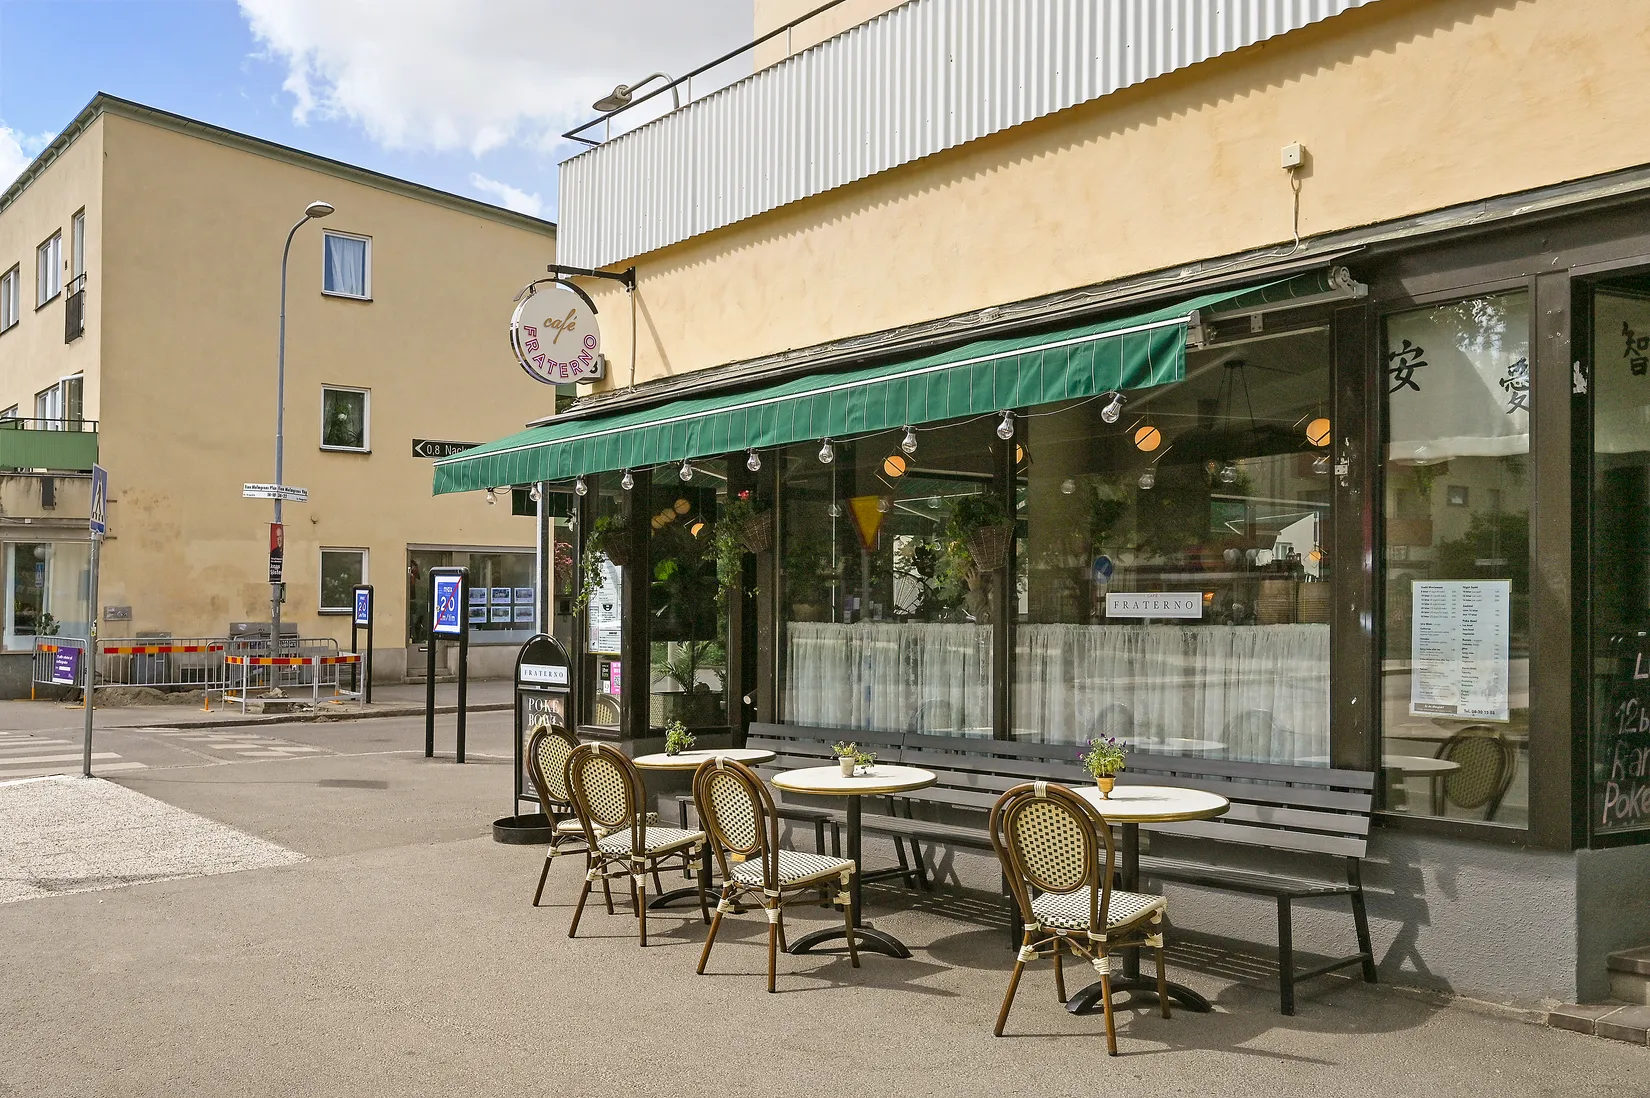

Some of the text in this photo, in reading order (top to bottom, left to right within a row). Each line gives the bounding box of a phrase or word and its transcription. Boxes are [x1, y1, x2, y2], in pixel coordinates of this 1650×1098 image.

[543, 308, 577, 345] café
[523, 325, 597, 379] FRATERNO
[1388, 338, 1429, 395] 安
[358, 602, 367, 612] 20
[440, 596, 455, 612] 20
[1113, 600, 1194, 610] FRATERNO
[524, 669, 564, 678] FRATERNO
[528, 697, 560, 713] POKE
